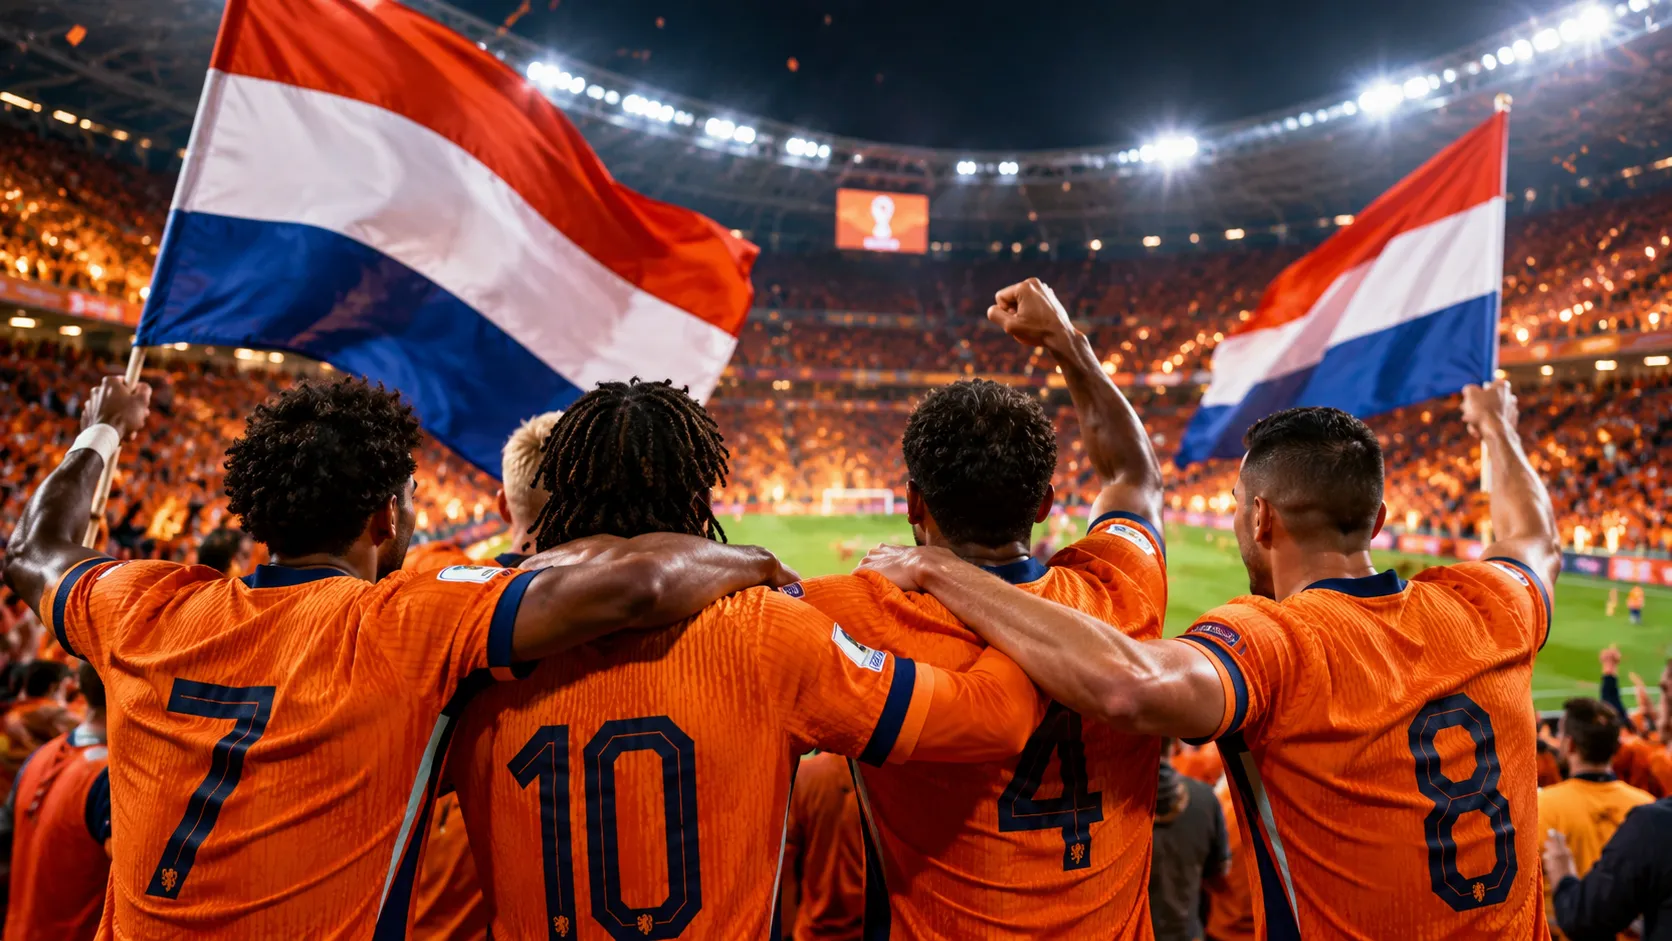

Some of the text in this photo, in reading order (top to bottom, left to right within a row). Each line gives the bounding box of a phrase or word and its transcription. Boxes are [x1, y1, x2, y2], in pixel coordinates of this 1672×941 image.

[145, 678, 276, 899] 7
[507, 716, 703, 941] 10
[998, 699, 1103, 870] 4
[1409, 694, 1517, 911] 8
